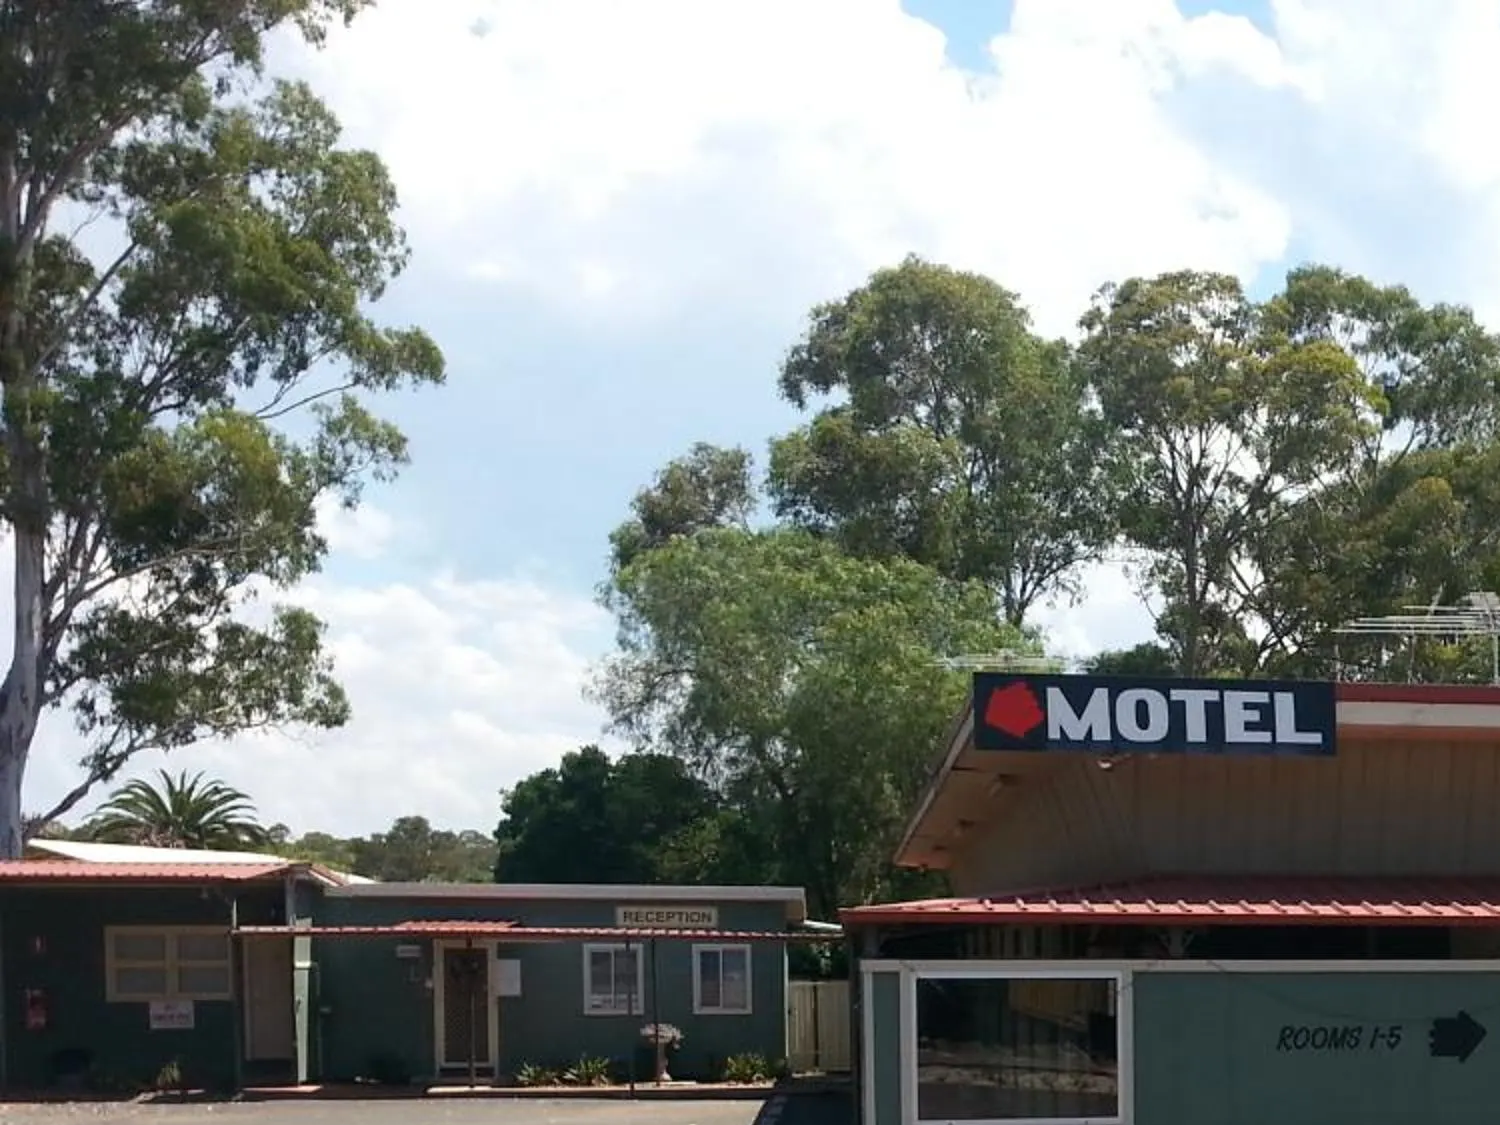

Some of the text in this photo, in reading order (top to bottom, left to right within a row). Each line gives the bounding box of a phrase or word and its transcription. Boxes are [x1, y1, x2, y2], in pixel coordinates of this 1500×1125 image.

[1046, 687, 1323, 744] MOTEL
[623, 911, 713, 923] RECEPTION
[1276, 1025, 1403, 1051] ROOMS 1-5
